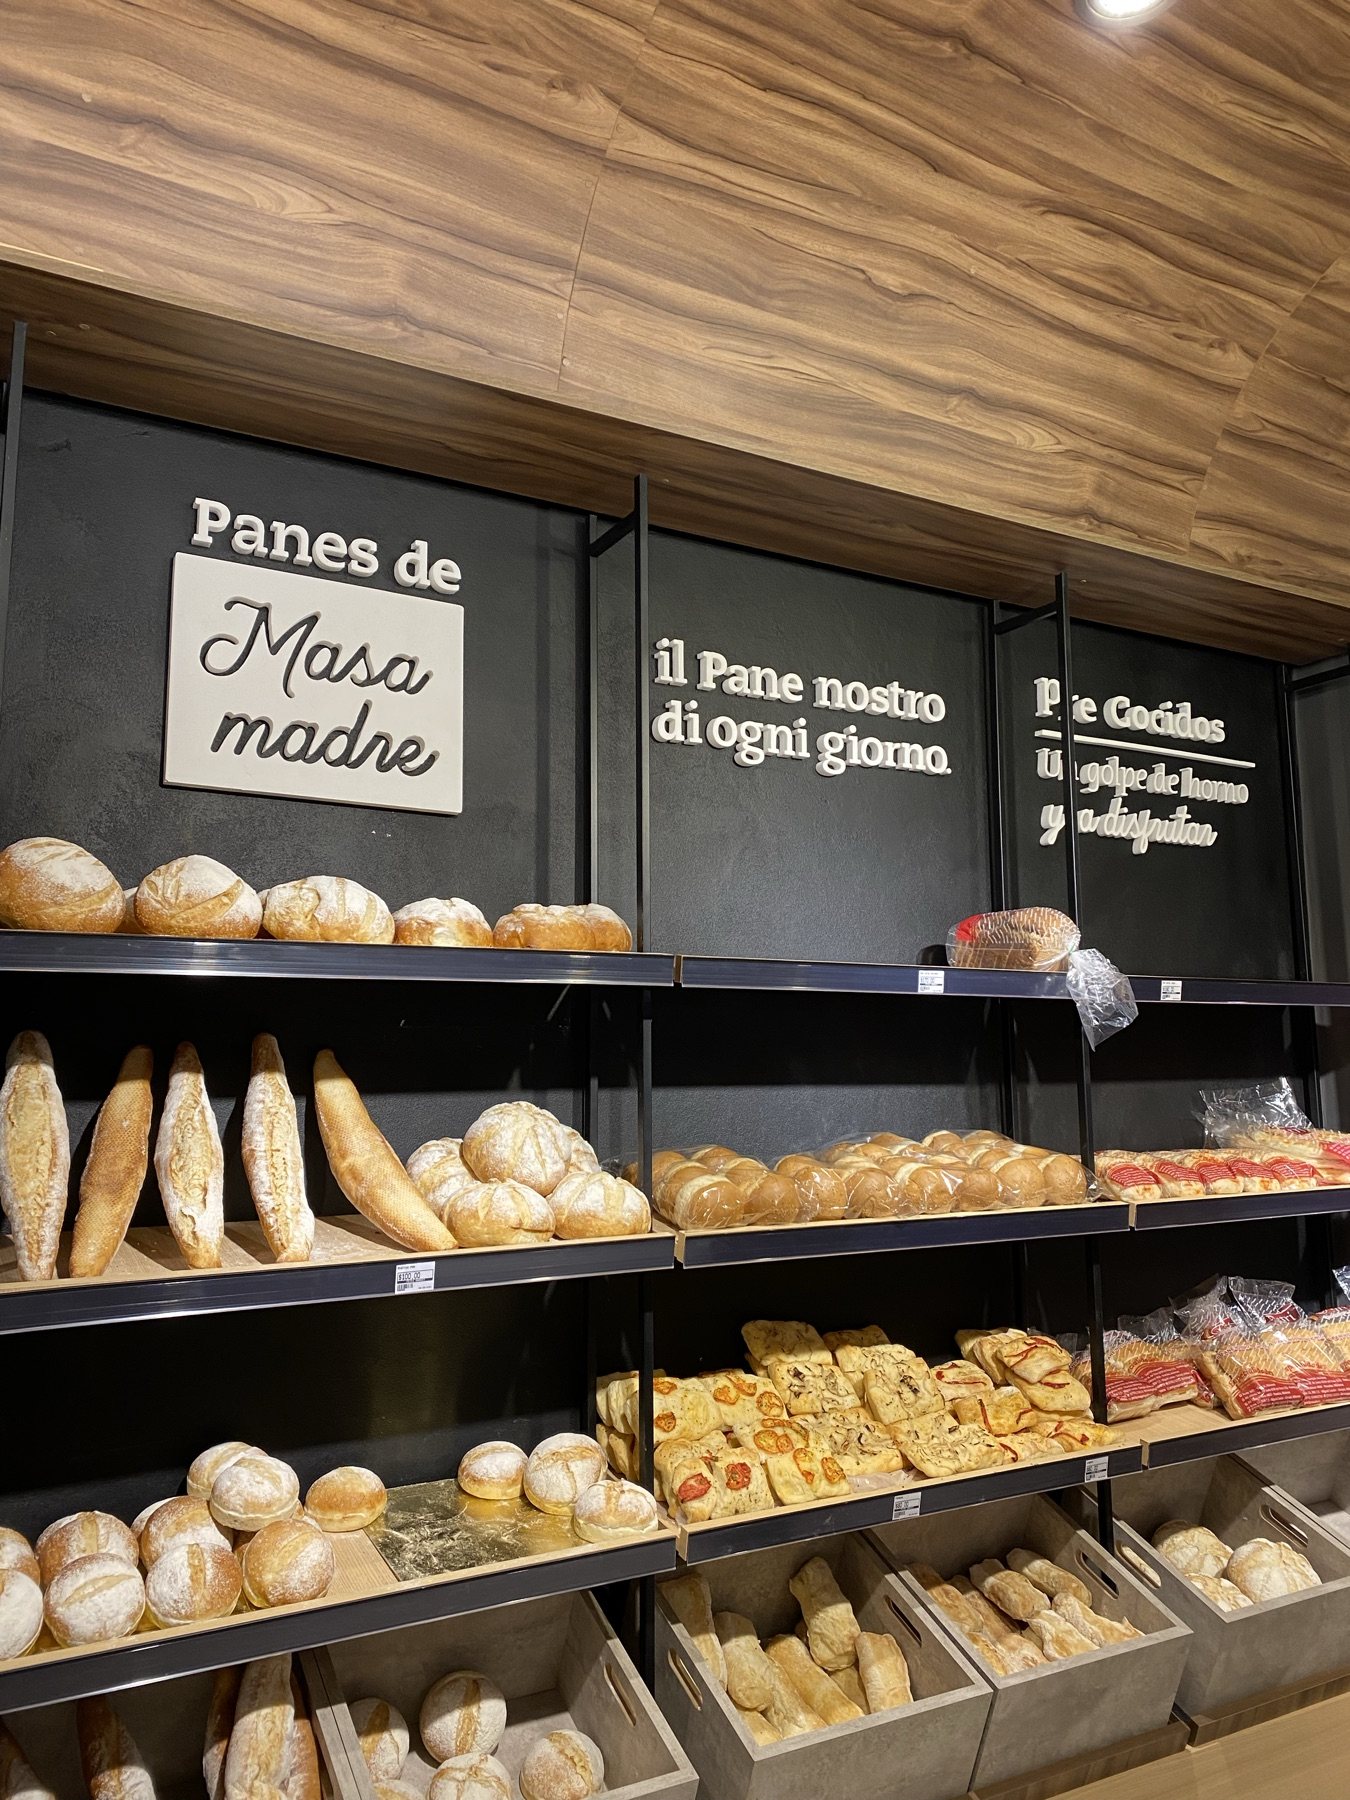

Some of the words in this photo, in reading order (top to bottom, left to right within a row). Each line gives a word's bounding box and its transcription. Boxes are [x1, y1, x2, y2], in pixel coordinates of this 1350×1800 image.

[191, 497, 379, 578] Panes
[393, 539, 462, 595] de
[199, 595, 434, 699] Masa
[653, 637, 688, 687] il
[696, 650, 804, 704] Pane
[812, 676, 946, 724] nostro
[210, 699, 440, 777] madre
[651, 699, 703, 746] di
[706, 714, 810, 767] ogni
[816, 724, 952, 777] giorno.
[1033, 676, 1098, 724] Pe
[1103, 695, 1226, 744] Cocidos
[1079, 755, 1148, 798] golpe
[1146, 762, 1179, 796] de
[1179, 767, 1249, 805] horno
[1096, 797, 1218, 856] disfrutar
